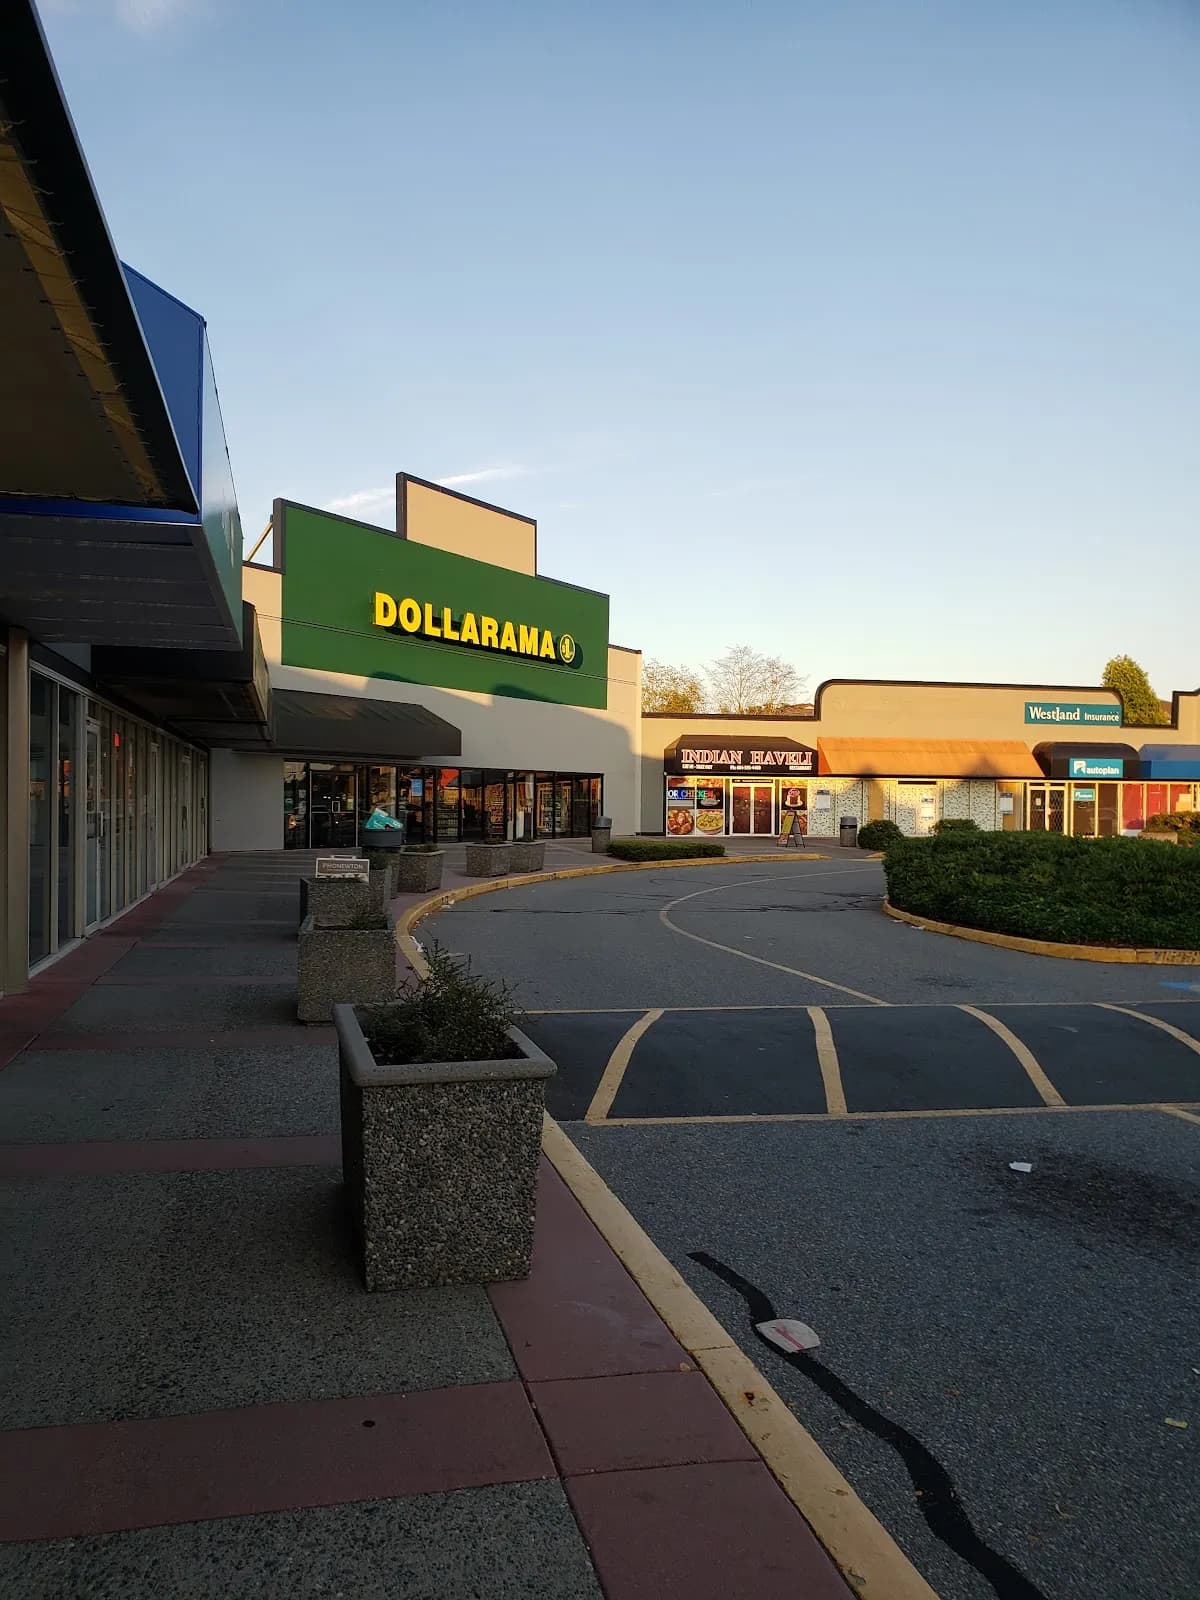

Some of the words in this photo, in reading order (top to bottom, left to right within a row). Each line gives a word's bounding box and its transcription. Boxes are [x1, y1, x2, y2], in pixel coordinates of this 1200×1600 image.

[375, 592, 556, 660] DOLLARAMA
[1029, 706, 1081, 721] Westland
[1085, 712, 1119, 722] Insurance
[681, 749, 743, 764] INDIAN
[750, 751, 813, 765] HAVELI
[1086, 766, 1120, 776] autoplan
